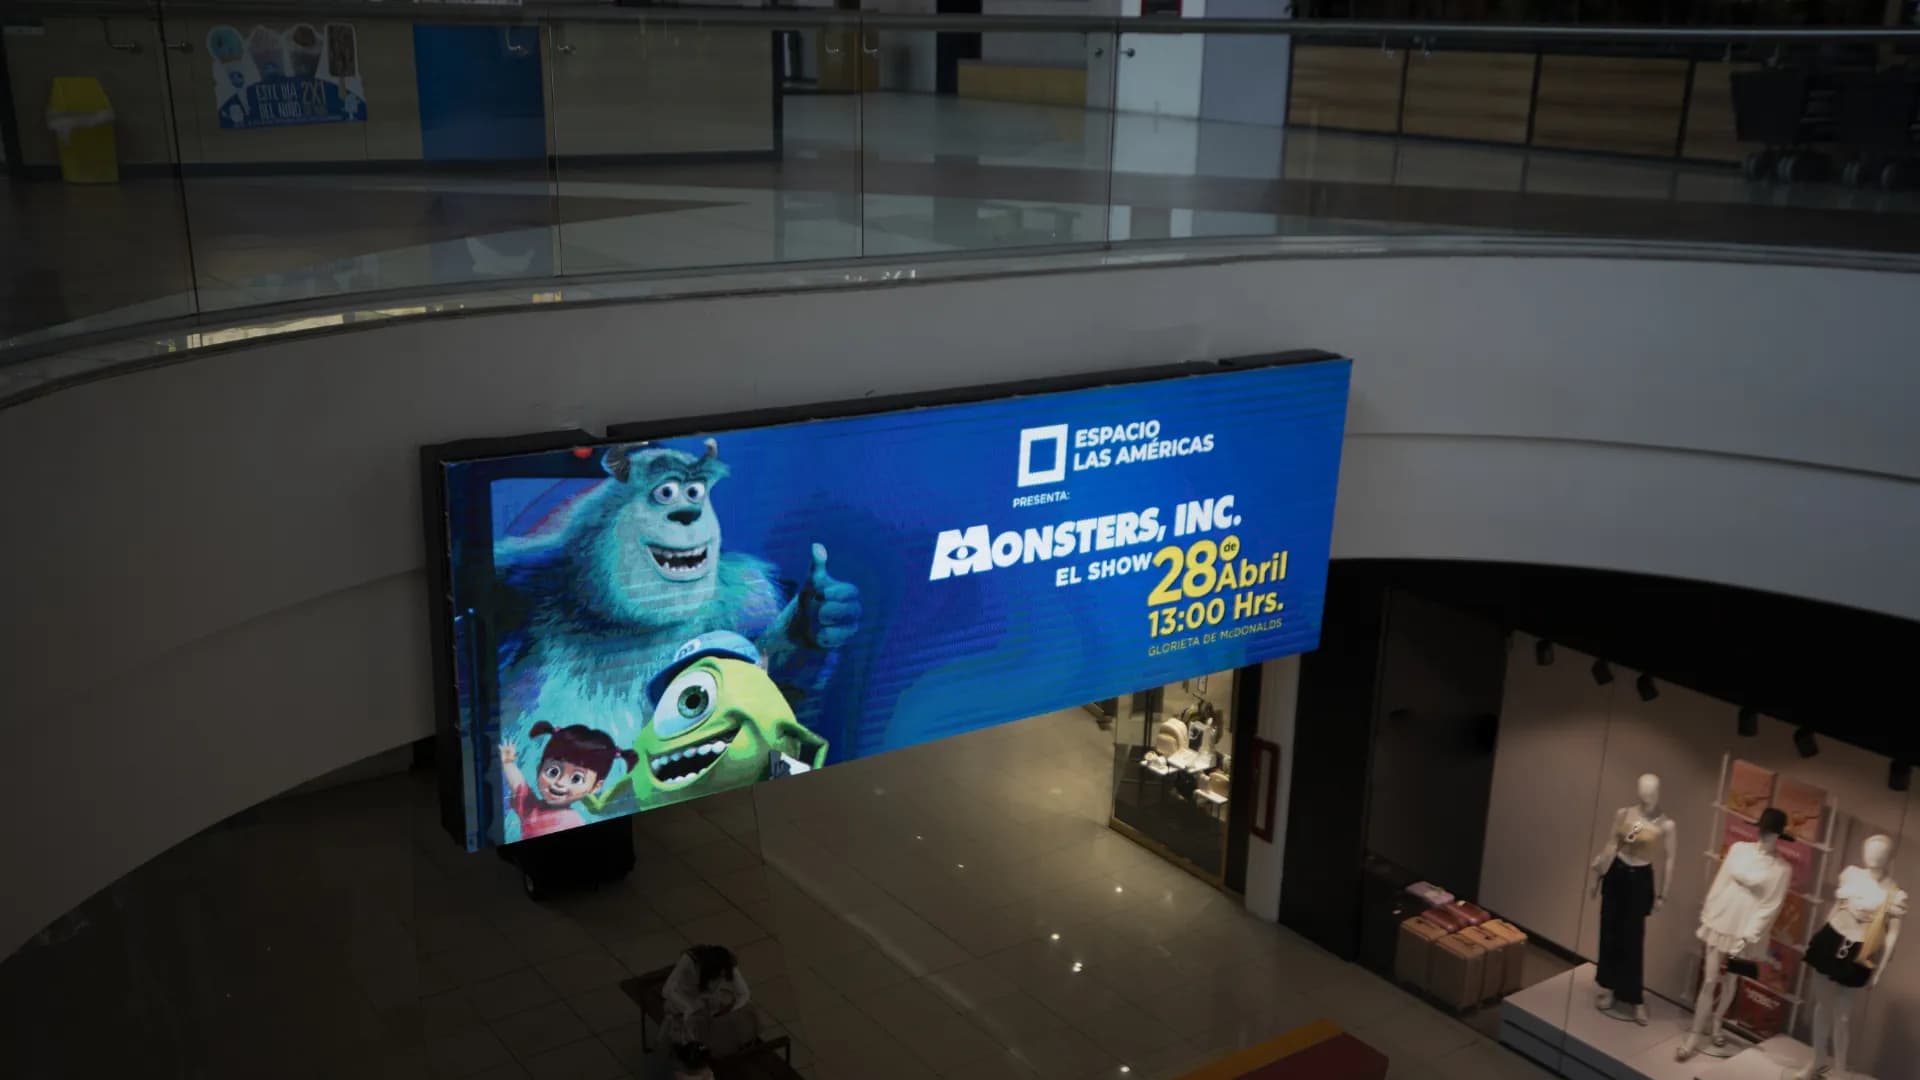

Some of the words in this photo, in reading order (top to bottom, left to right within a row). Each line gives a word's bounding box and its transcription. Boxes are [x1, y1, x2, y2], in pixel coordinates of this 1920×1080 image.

[1072, 448, 1111, 472] LAS
[1115, 433, 1215, 465] AMÉRICAS
[1075, 419, 1161, 449] ESPACIO
[1012, 491, 1071, 508] PRESENTA:
[1174, 494, 1242, 537] INC.
[1223, 541, 1237, 552] de
[1055, 565, 1082, 587] EL
[1088, 551, 1153, 581] SHOW
[1147, 539, 1218, 607] 28
[1215, 550, 1288, 593] Abril
[1148, 597, 1226, 638] 13:00
[1233, 591, 1284, 620] Hrs.
[1148, 637, 1201, 657] GLORIETA
[1203, 632, 1217, 645] DE
[1220, 618, 1284, 641] McDONALDS
